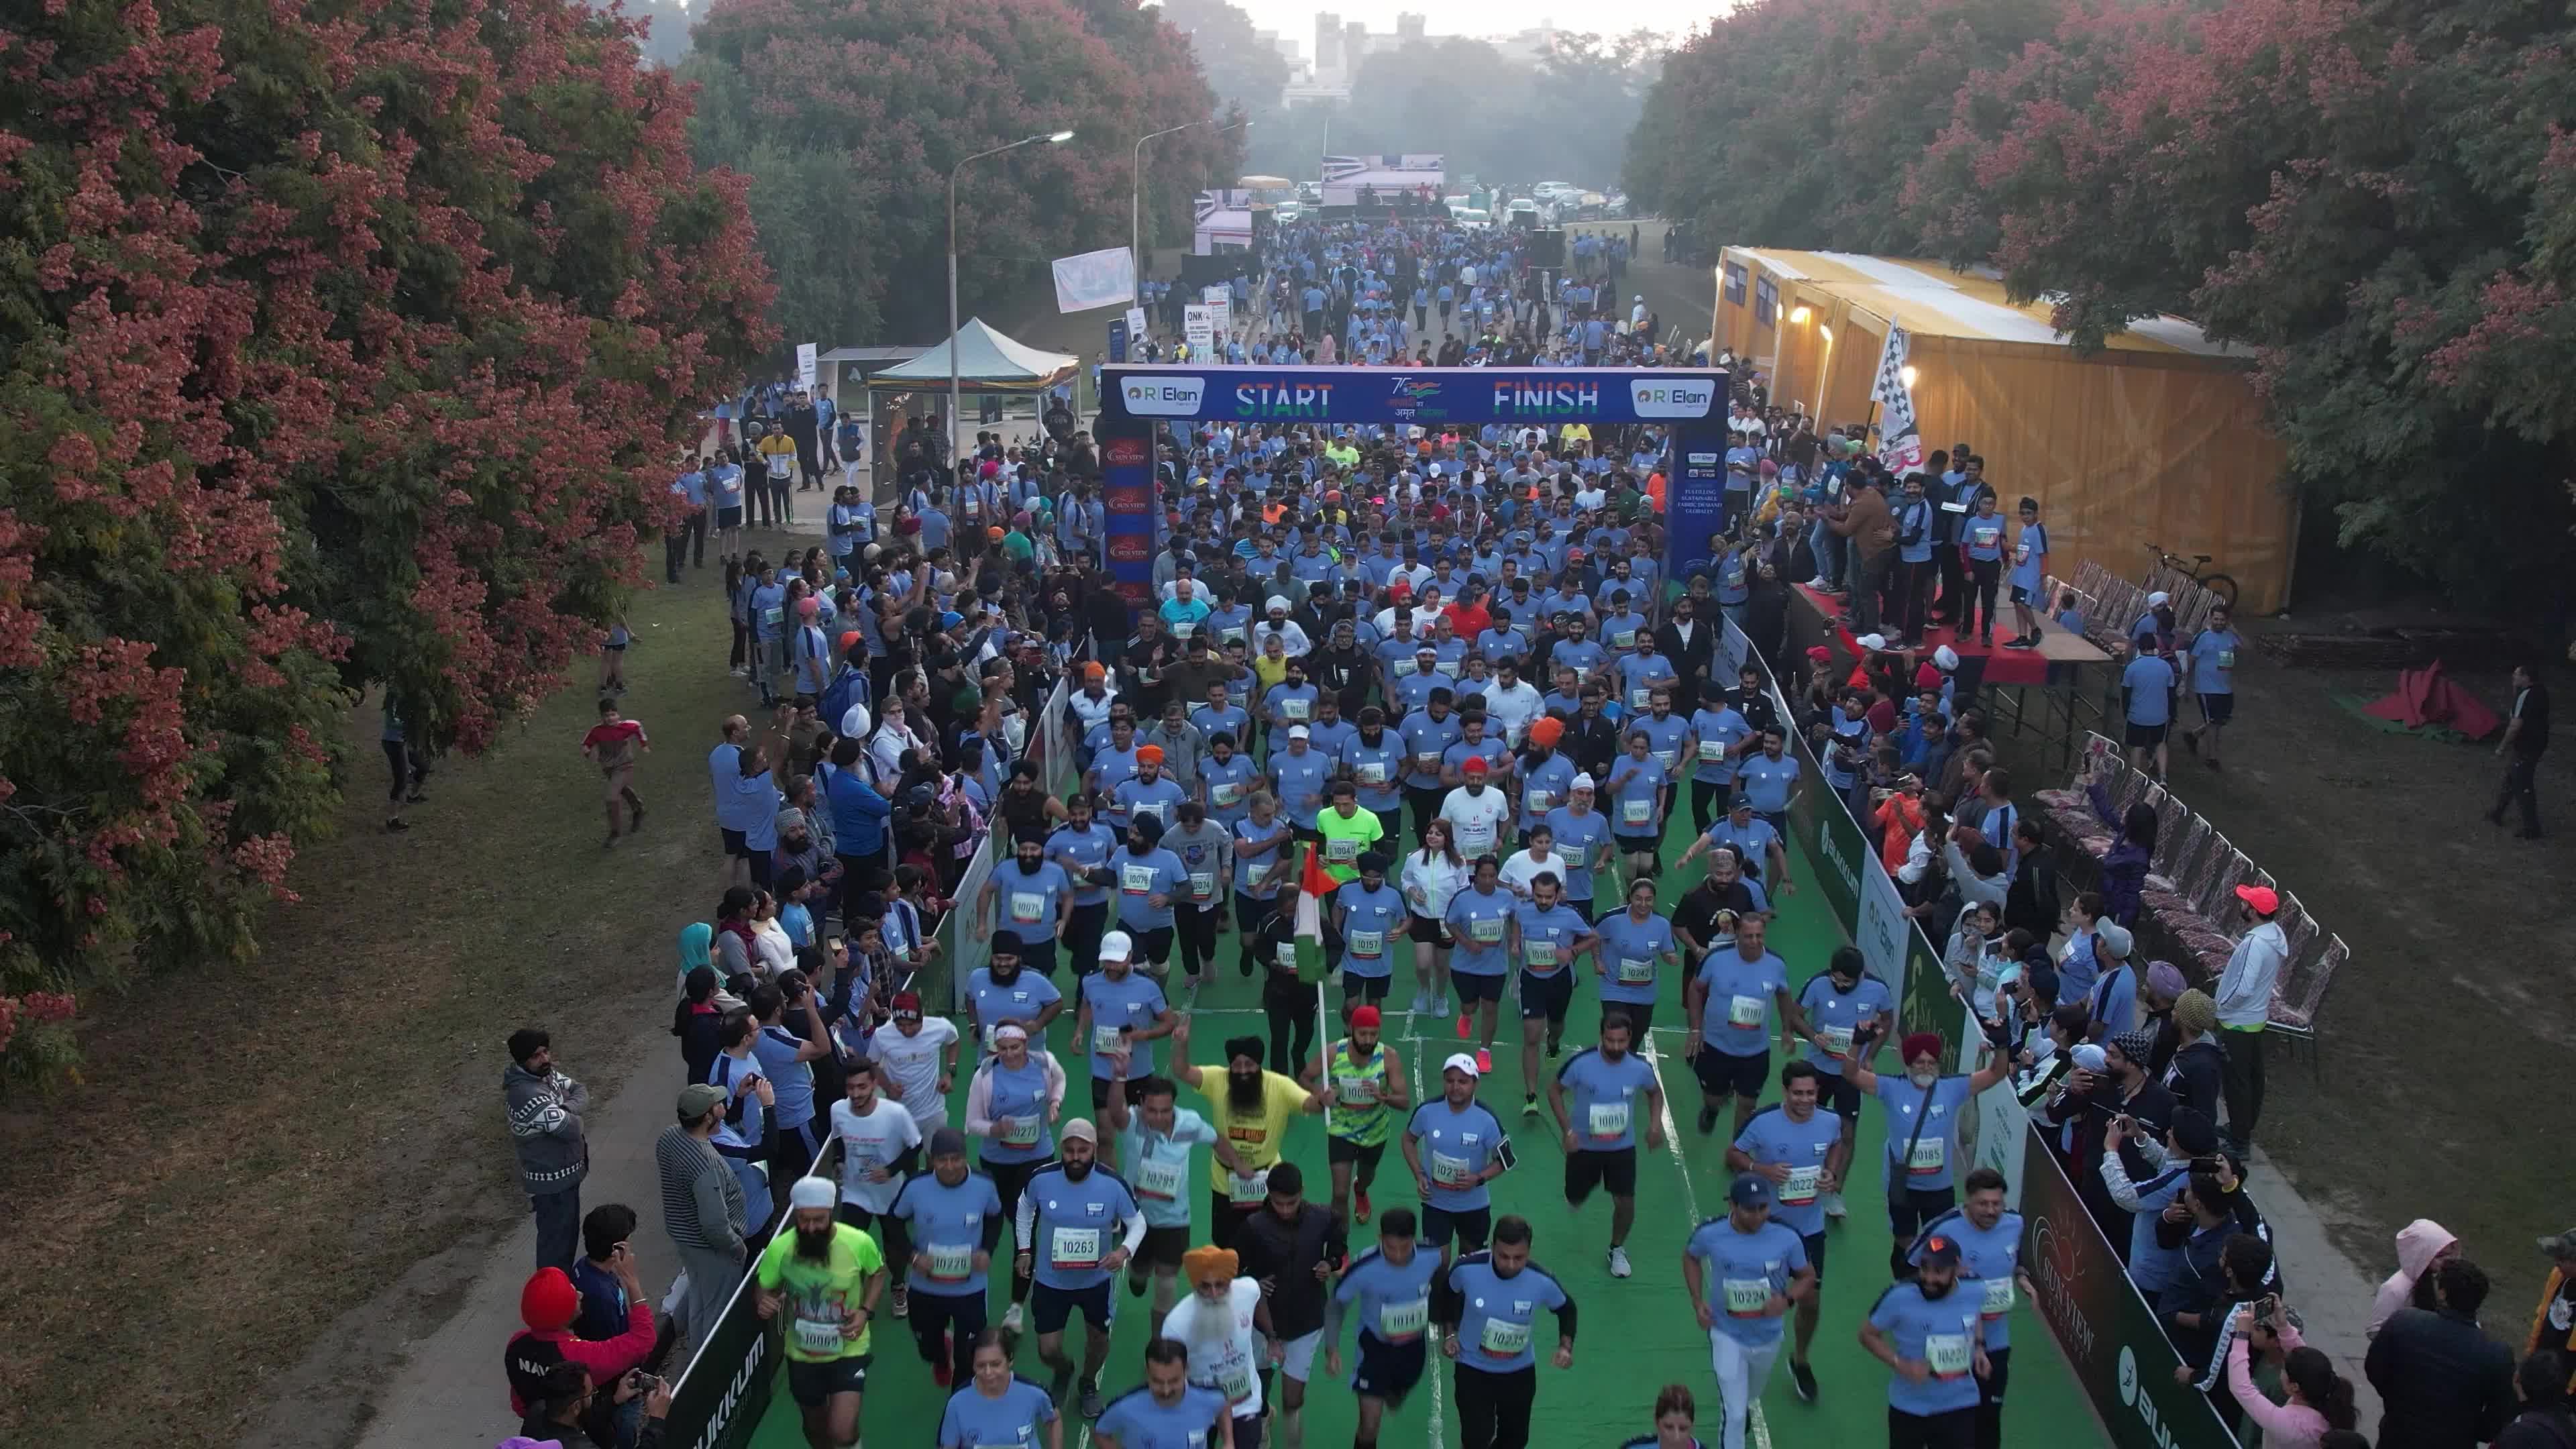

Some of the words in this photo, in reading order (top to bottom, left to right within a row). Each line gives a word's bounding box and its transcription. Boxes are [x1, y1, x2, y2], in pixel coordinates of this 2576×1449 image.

[1144, 387, 1155, 400] R
[1163, 387, 1197, 401] Elan
[1235, 380, 1333, 417] START
[1493, 380, 1599, 415] FINISH
[1654, 390, 1665, 403] R
[1672, 390, 1707, 403] Elan
[1334, 846, 1356, 855] 10040
[1063, 1240, 1095, 1254] 10263
[2043, 1256, 2065, 1305] SUN
[2065, 1289, 2095, 1353] VIEW
